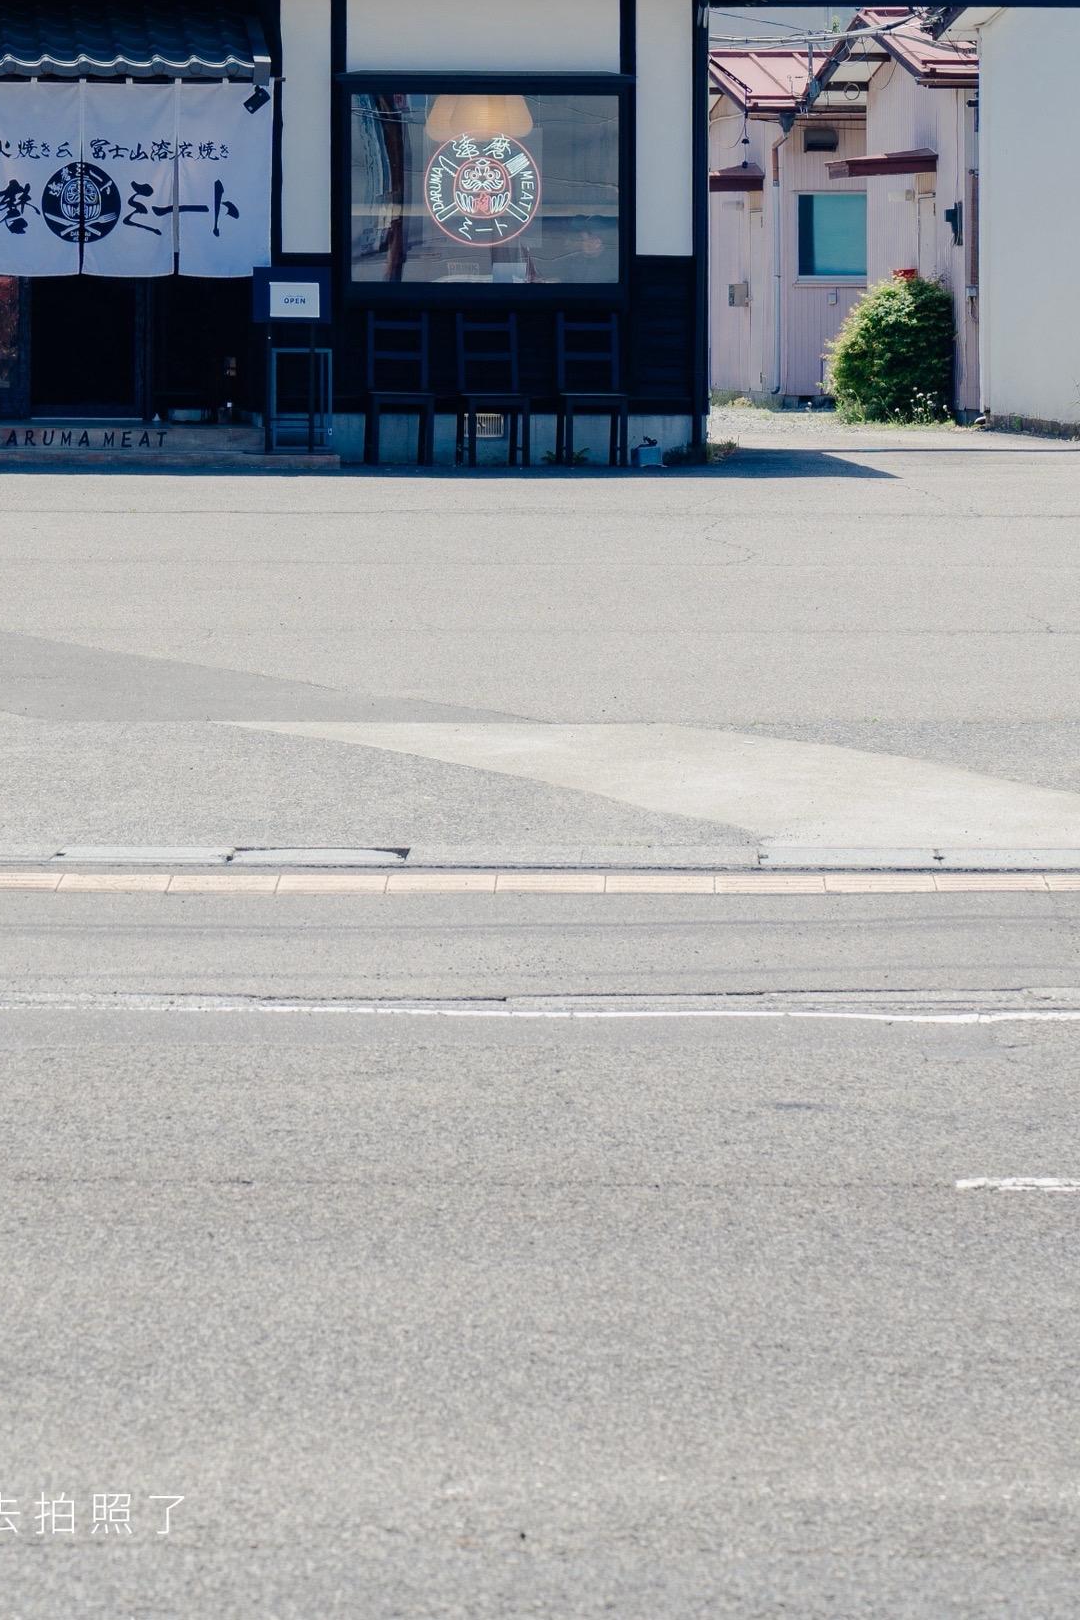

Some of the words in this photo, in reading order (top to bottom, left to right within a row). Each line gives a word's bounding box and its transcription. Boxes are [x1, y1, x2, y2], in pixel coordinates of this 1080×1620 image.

[122, 179, 240, 237] ミート
[428, 167, 445, 212] DARUMA
[518, 170, 535, 212] MEAT
[103, 430, 168, 448] MEAT
